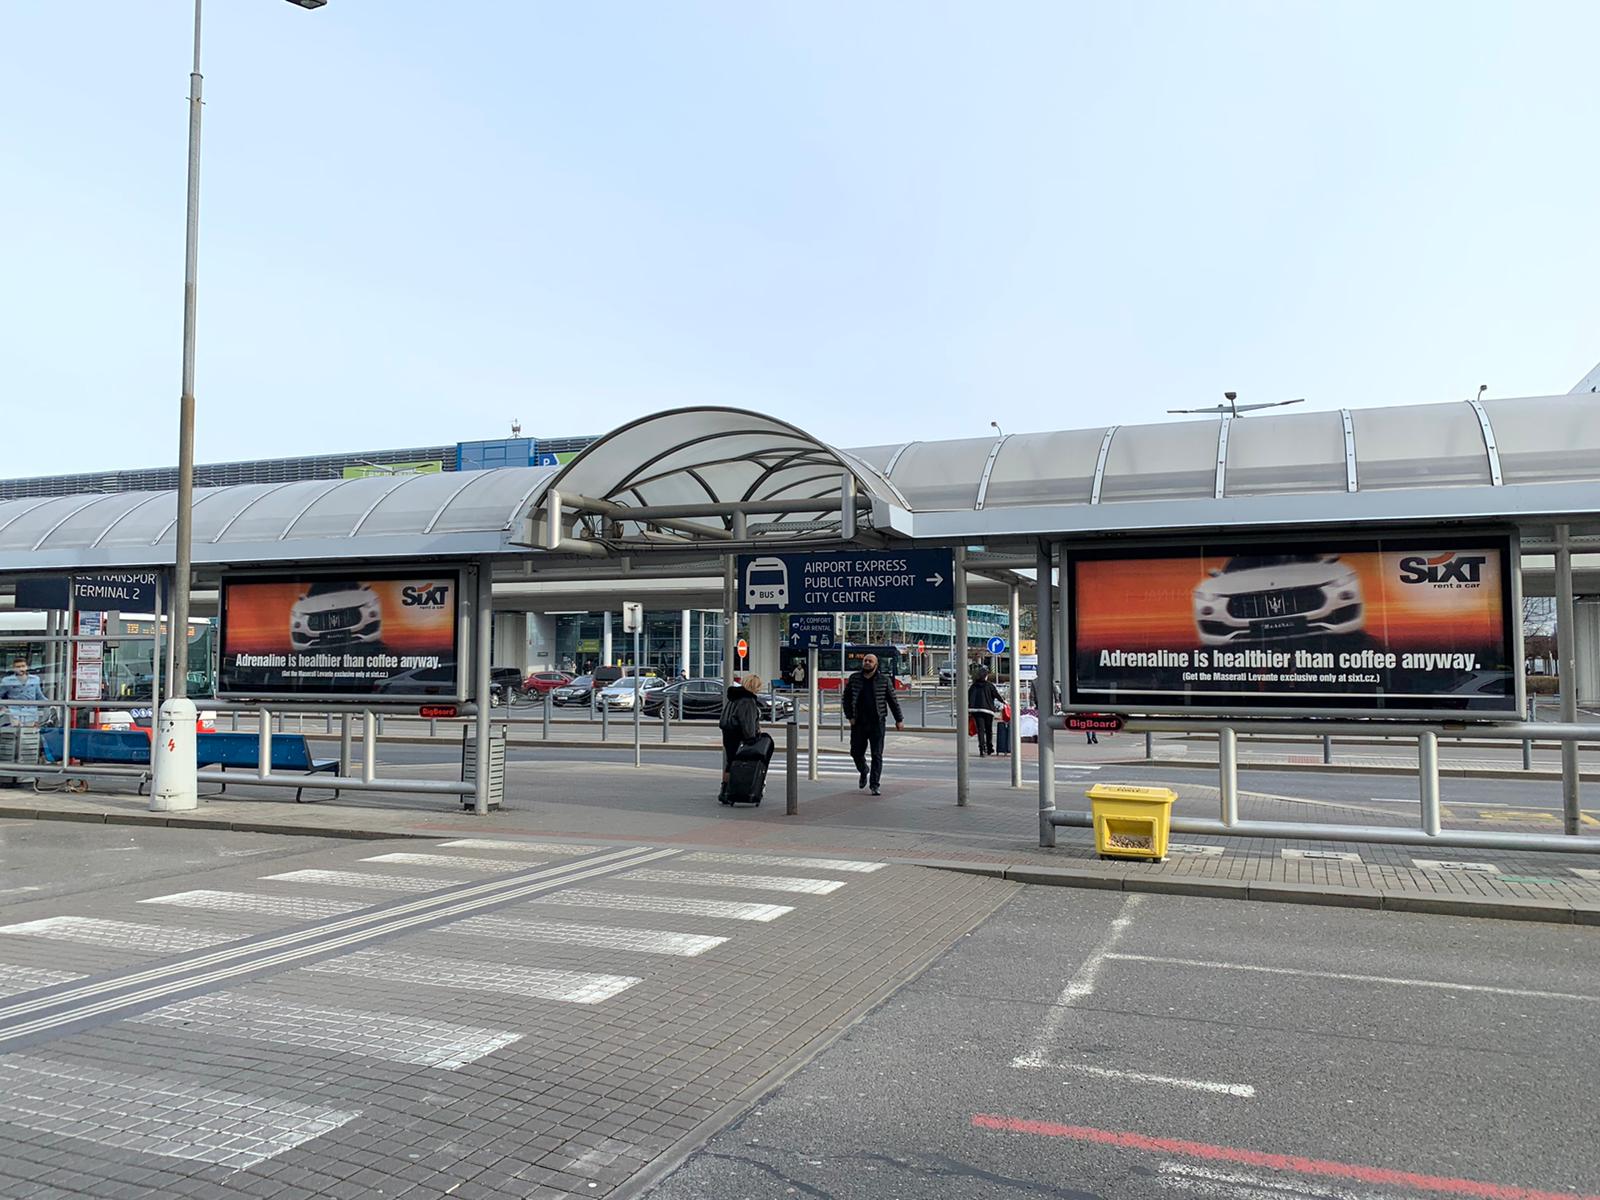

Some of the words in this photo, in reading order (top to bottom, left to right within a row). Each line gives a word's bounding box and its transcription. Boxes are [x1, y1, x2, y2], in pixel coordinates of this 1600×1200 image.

[804, 561, 852, 574] AIRPORT
[855, 559, 907, 573] EXPRESS
[804, 576, 844, 589] PUBLIC
[846, 575, 916, 588] TRANSPORT
[75, 584, 130, 599] TERMINAL
[132, 588, 140, 600] 2
[759, 591, 775, 599] BUS
[804, 592, 829, 604] CITY
[832, 591, 876, 603] CENTRE
[235, 653, 287, 667] Adrenaline
[288, 653, 297, 667] is
[298, 654, 342, 667] healthier
[343, 654, 364, 668] than
[366, 655, 398, 668] coffee
[400, 656, 442, 670] anyway.
[1099, 649, 1189, 668] Adrenaline
[1193, 649, 1209, 668] is
[1213, 649, 1291, 669] healthier
[1295, 650, 1335, 670] than
[1339, 651, 1397, 670] coffee
[1401, 653, 1481, 672] anyway.
[1182, 671, 1199, 682] (Get
[1200, 672, 1212, 681] the
[1213, 671, 1247, 681] Maserati
[1248, 672, 1278, 682] Levante
[1280, 672, 1317, 682] exclusive
[1318, 673, 1337, 685] only
[1338, 673, 1346, 682] at
[1348, 673, 1380, 684] sixt.cz.)
[1069, 719, 1118, 731] BigBoard
